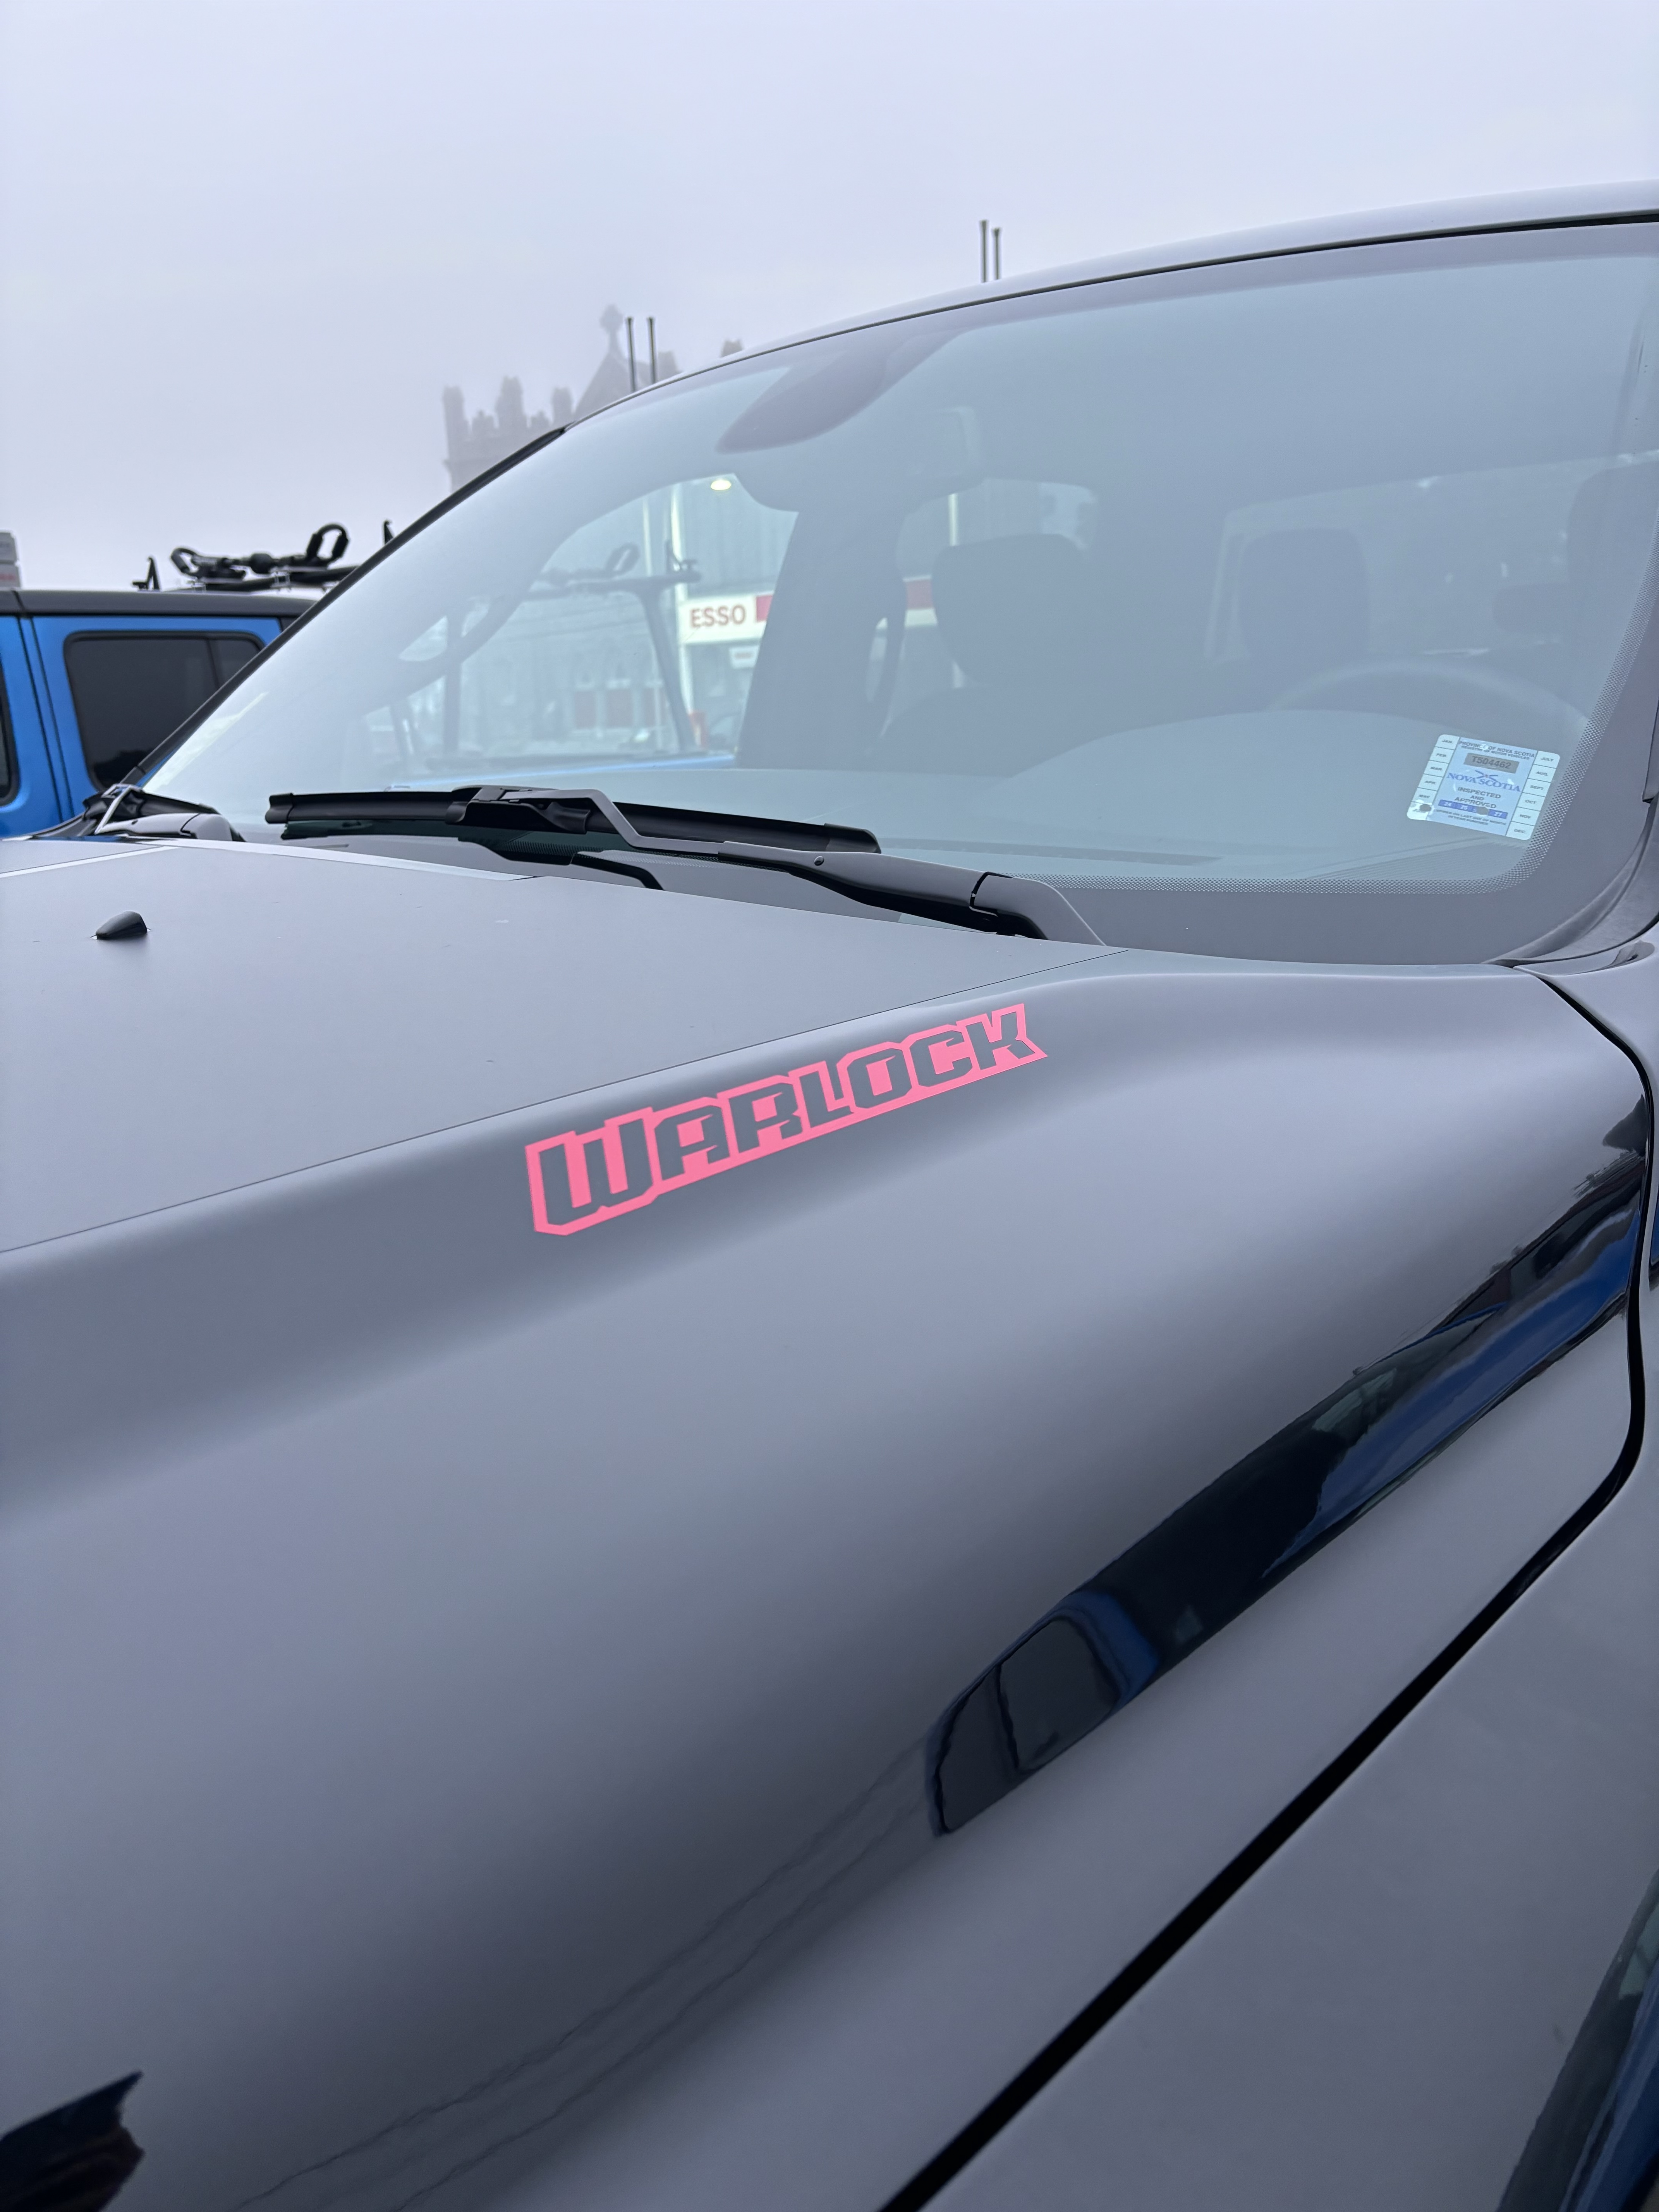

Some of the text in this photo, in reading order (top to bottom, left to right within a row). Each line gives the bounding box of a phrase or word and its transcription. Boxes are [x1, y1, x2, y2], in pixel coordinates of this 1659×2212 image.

[690, 605, 746, 629] ESSO
[1459, 740, 1487, 749] PROVINCE
[1472, 756, 1511, 769] T504462
[1447, 773, 1520, 792] NOVA SCOTIA
[1458, 787, 1501, 799] INSPECTED
[1454, 797, 1496, 809] APPROVED
[527, 1004, 1046, 1235] WARLOCK
